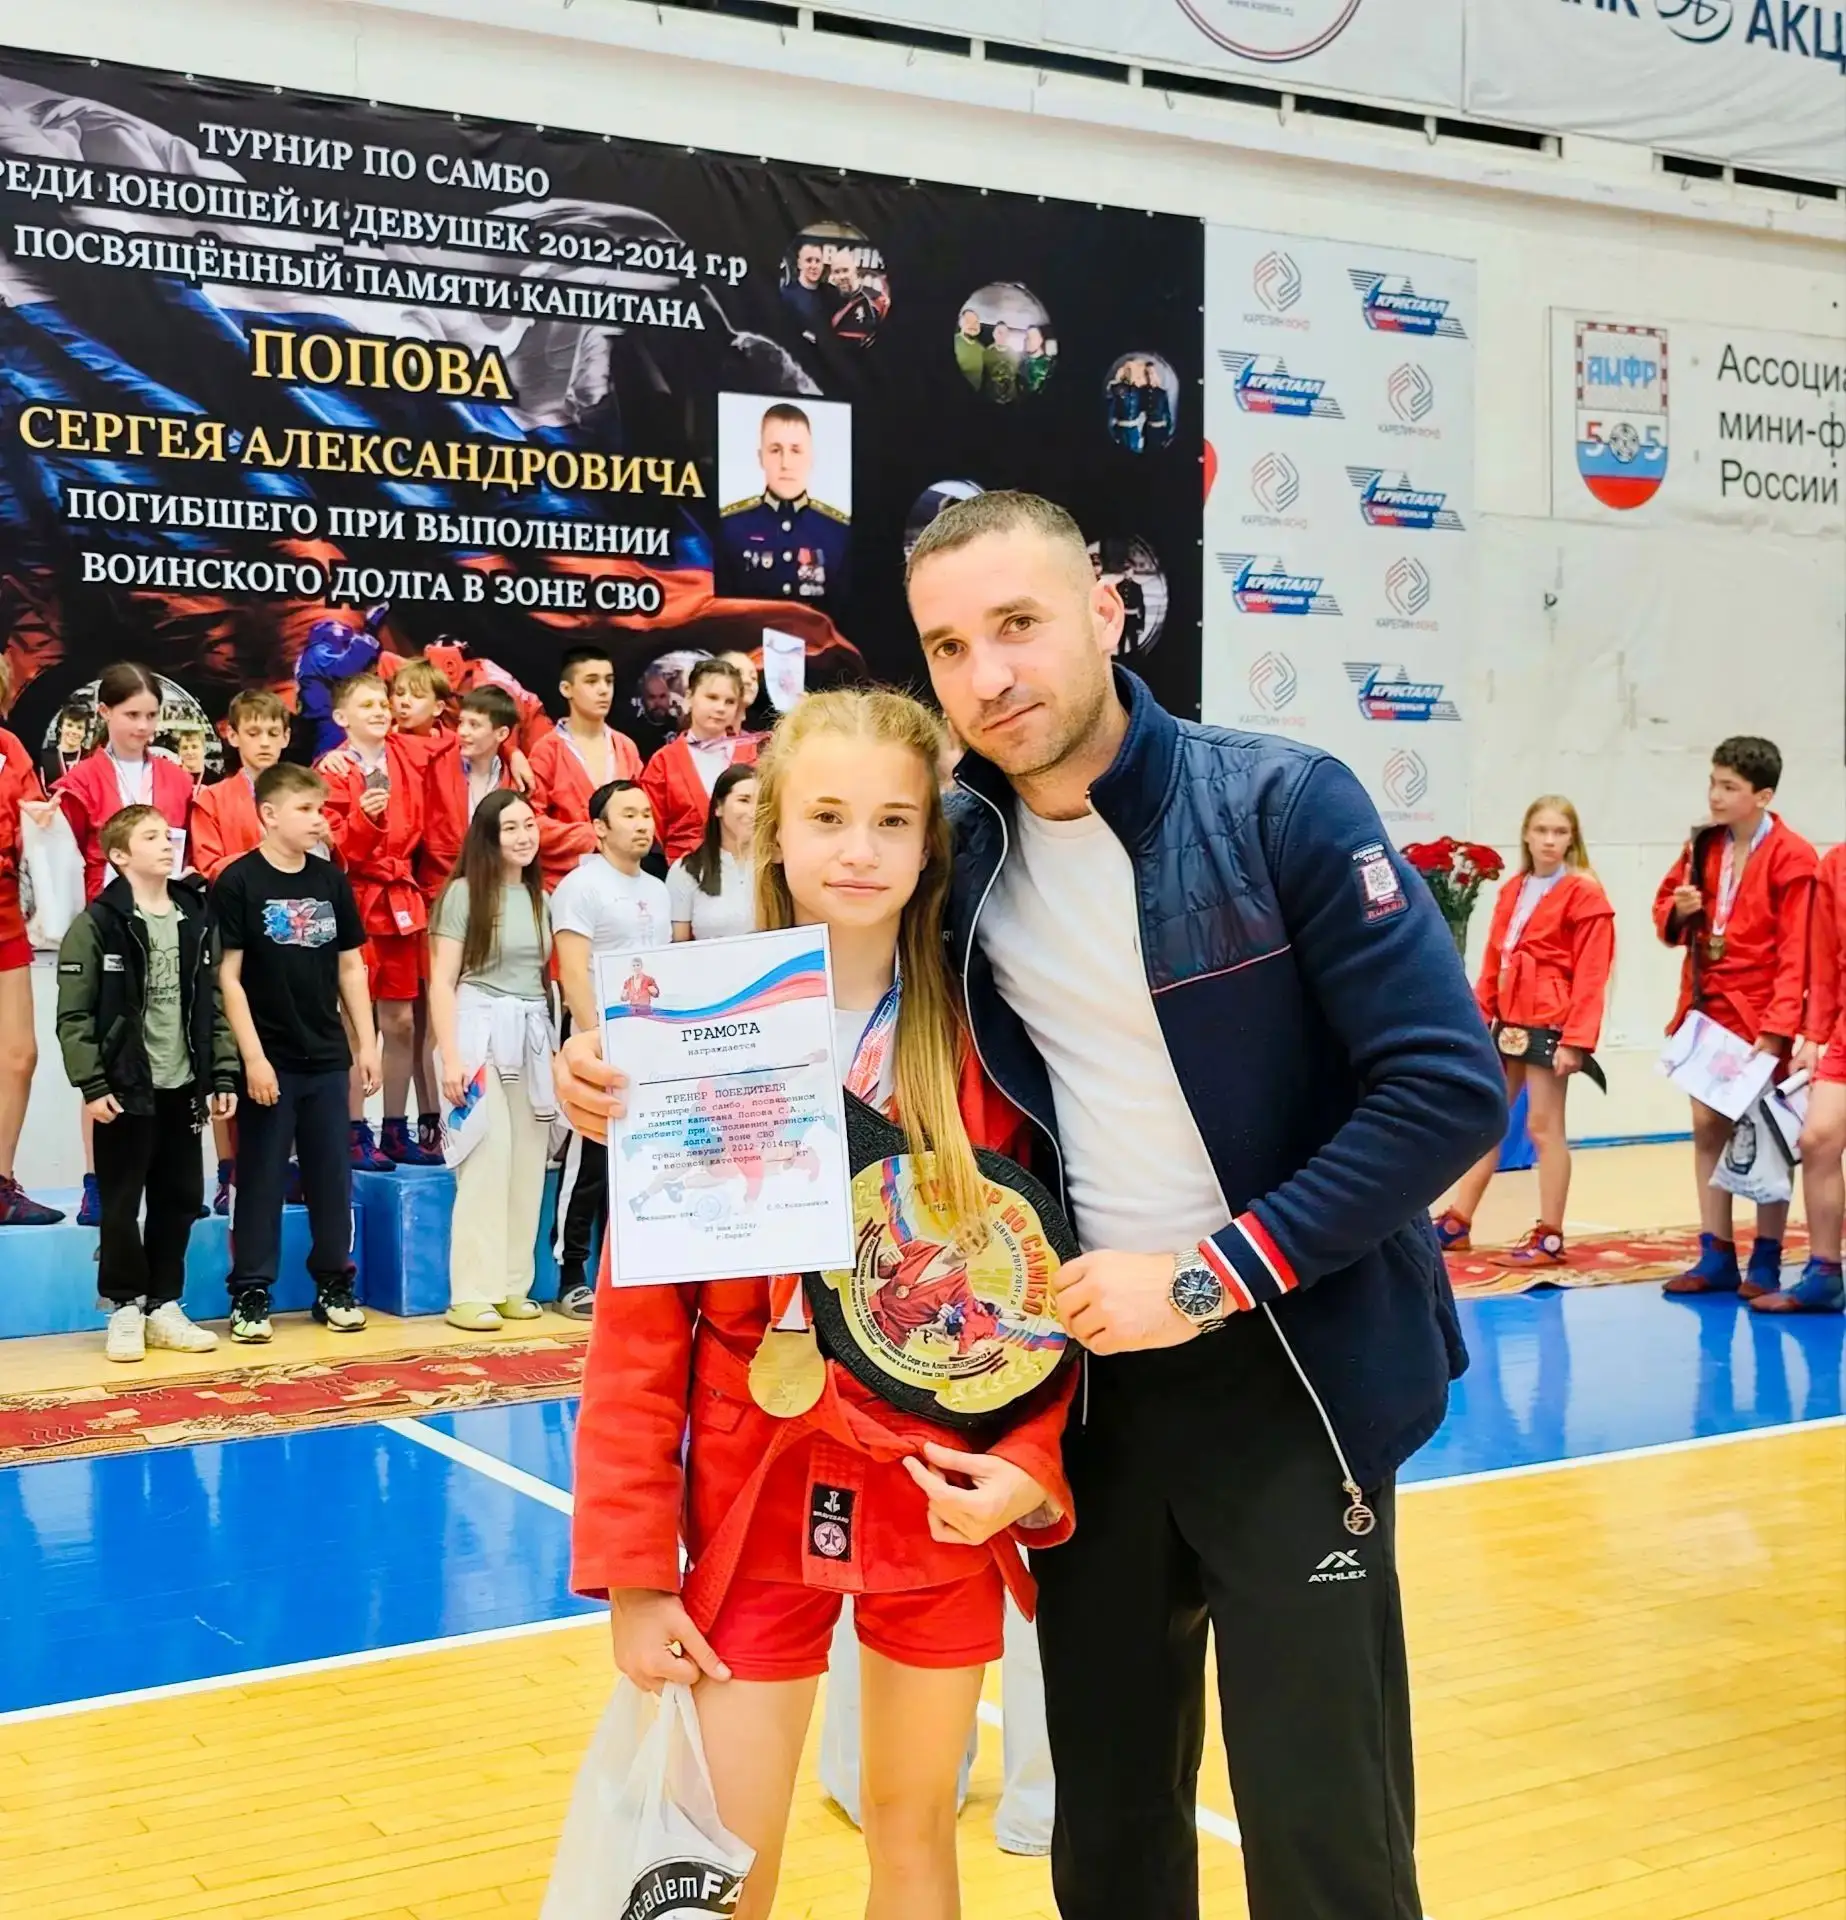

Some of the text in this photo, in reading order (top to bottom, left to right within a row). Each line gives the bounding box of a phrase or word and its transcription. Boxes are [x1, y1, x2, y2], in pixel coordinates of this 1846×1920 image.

[199, 122, 550, 197] ТУРНИР ПО САМБО
[0, 160, 748, 286] ЕДИ ЮНОШЕЙ И ДЕВУШЕК 2012-2014 г.р
[14, 224, 706, 330] ПОСВЯЩЁННЫЙ ПАМЯТИ КАПИТАНА
[1375, 295, 1447, 314] КРИСТАЛЛ
[250, 328, 513, 400] ПОПОВА
[1587, 354, 1658, 388] АМФР
[1247, 374, 1322, 395] КРИСТАЛЛ
[19, 405, 706, 498] СЕРГЕЯ АЛЕКСАНДРОВИЧА
[1585, 421, 1664, 462] 5 5
[1721, 459, 1838, 504] России
[1373, 490, 1446, 507] КРИСТАЛЛ
[67, 487, 671, 556] ПОГИБШЕГО ПРИ ВЫПОЛНЕНИИ
[81, 552, 660, 612] ВОИНСКОГО ДОЛГА В ЗОНЕ СВО
[1245, 576, 1319, 592] КРИСТАЛЛ
[1369, 684, 1440, 698] КРИСТАЛЛ
[681, 1021, 761, 1043] ГРАМОТА
[688, 1042, 757, 1057] награждается
[665, 1082, 787, 1104] ТРЕНЕР ПОБЕДИТЕЛЯ
[648, 1119, 682, 1129] памяти
[687, 1113, 733, 1125] капитана
[738, 1110, 773, 1119] Попова
[695, 1105, 707, 1113] по
[631, 1115, 826, 1140] погибшего при выполнении воинского
[683, 1137, 712, 1147] долга
[756, 1130, 775, 1139] СВО
[686, 1147, 726, 1157] девушек
[709, 1154, 762, 1165] категории
[1001, 1204, 1049, 1316] ПО САМБО
[1307, 1569, 1367, 1583] ATHLEX
